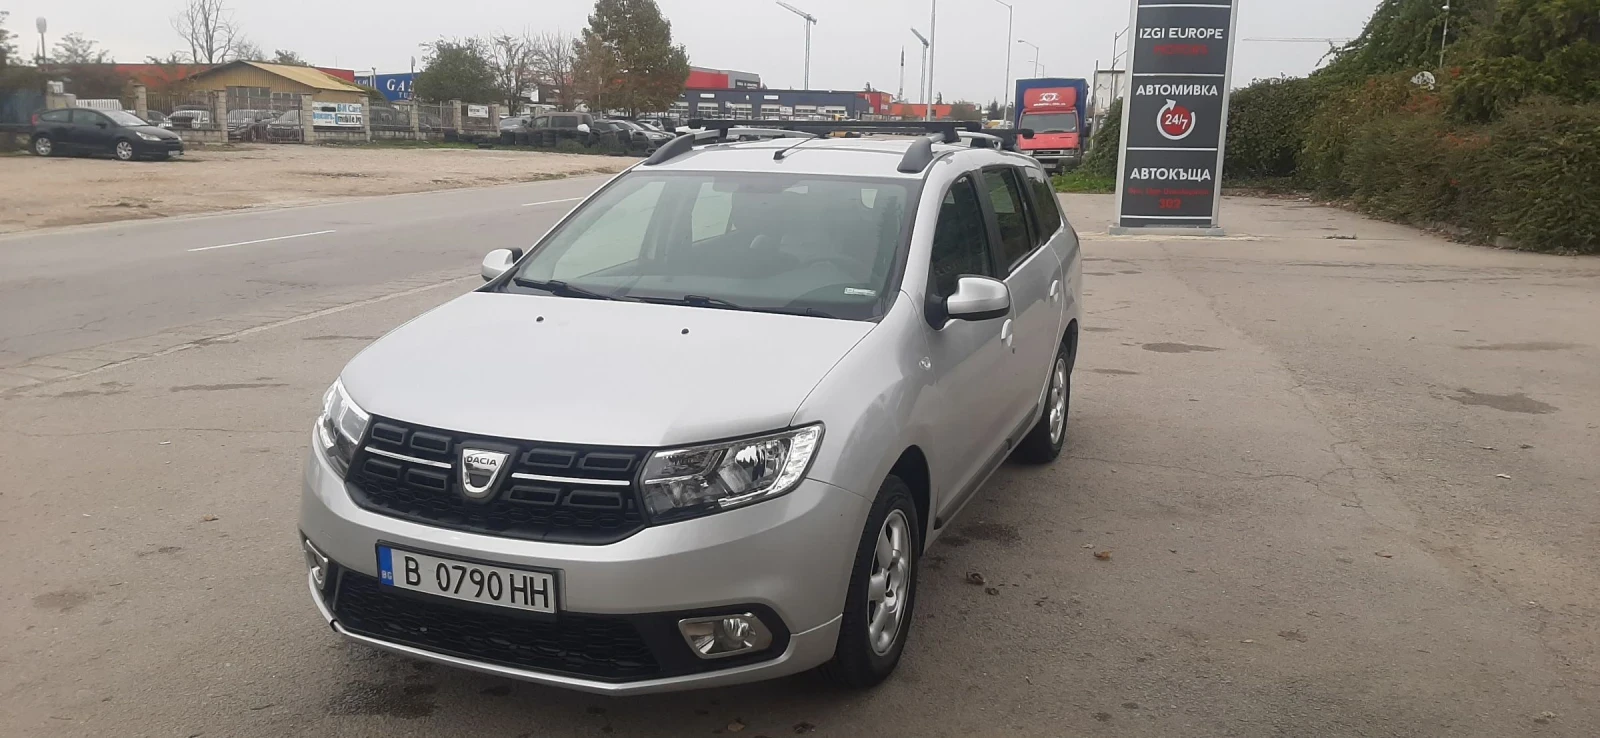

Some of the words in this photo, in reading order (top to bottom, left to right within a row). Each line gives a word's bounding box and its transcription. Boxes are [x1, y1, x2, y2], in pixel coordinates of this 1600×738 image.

[1139, 27, 1165, 39] IZGI
[1168, 27, 1224, 39] EUROPE
[1135, 84, 1218, 96] АВТОМИВКА
[1165, 113, 1188, 130] 24/7
[1129, 168, 1211, 182] АВТОКЪЩА
[465, 455, 498, 467] DACIA
[381, 569, 393, 580] BG
[404, 556, 421, 586] B
[436, 562, 503, 601] 0790
[509, 573, 549, 608] HH
